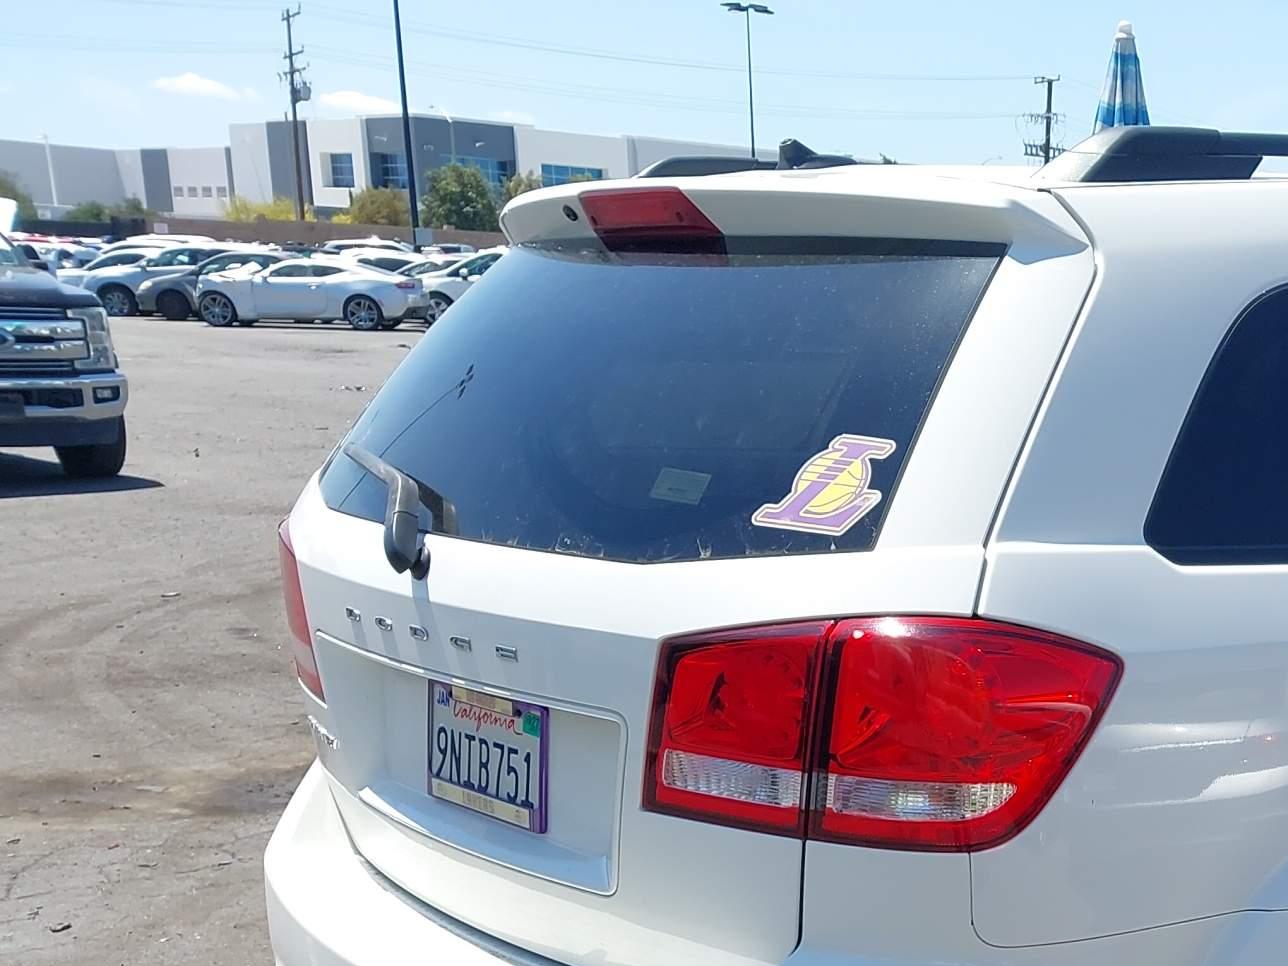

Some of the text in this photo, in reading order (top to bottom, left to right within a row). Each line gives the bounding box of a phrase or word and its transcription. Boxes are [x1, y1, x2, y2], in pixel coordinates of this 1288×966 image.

[346, 606, 519, 663] DODGE
[437, 687, 450, 707] JAN
[435, 725, 534, 809] 9NIB751
